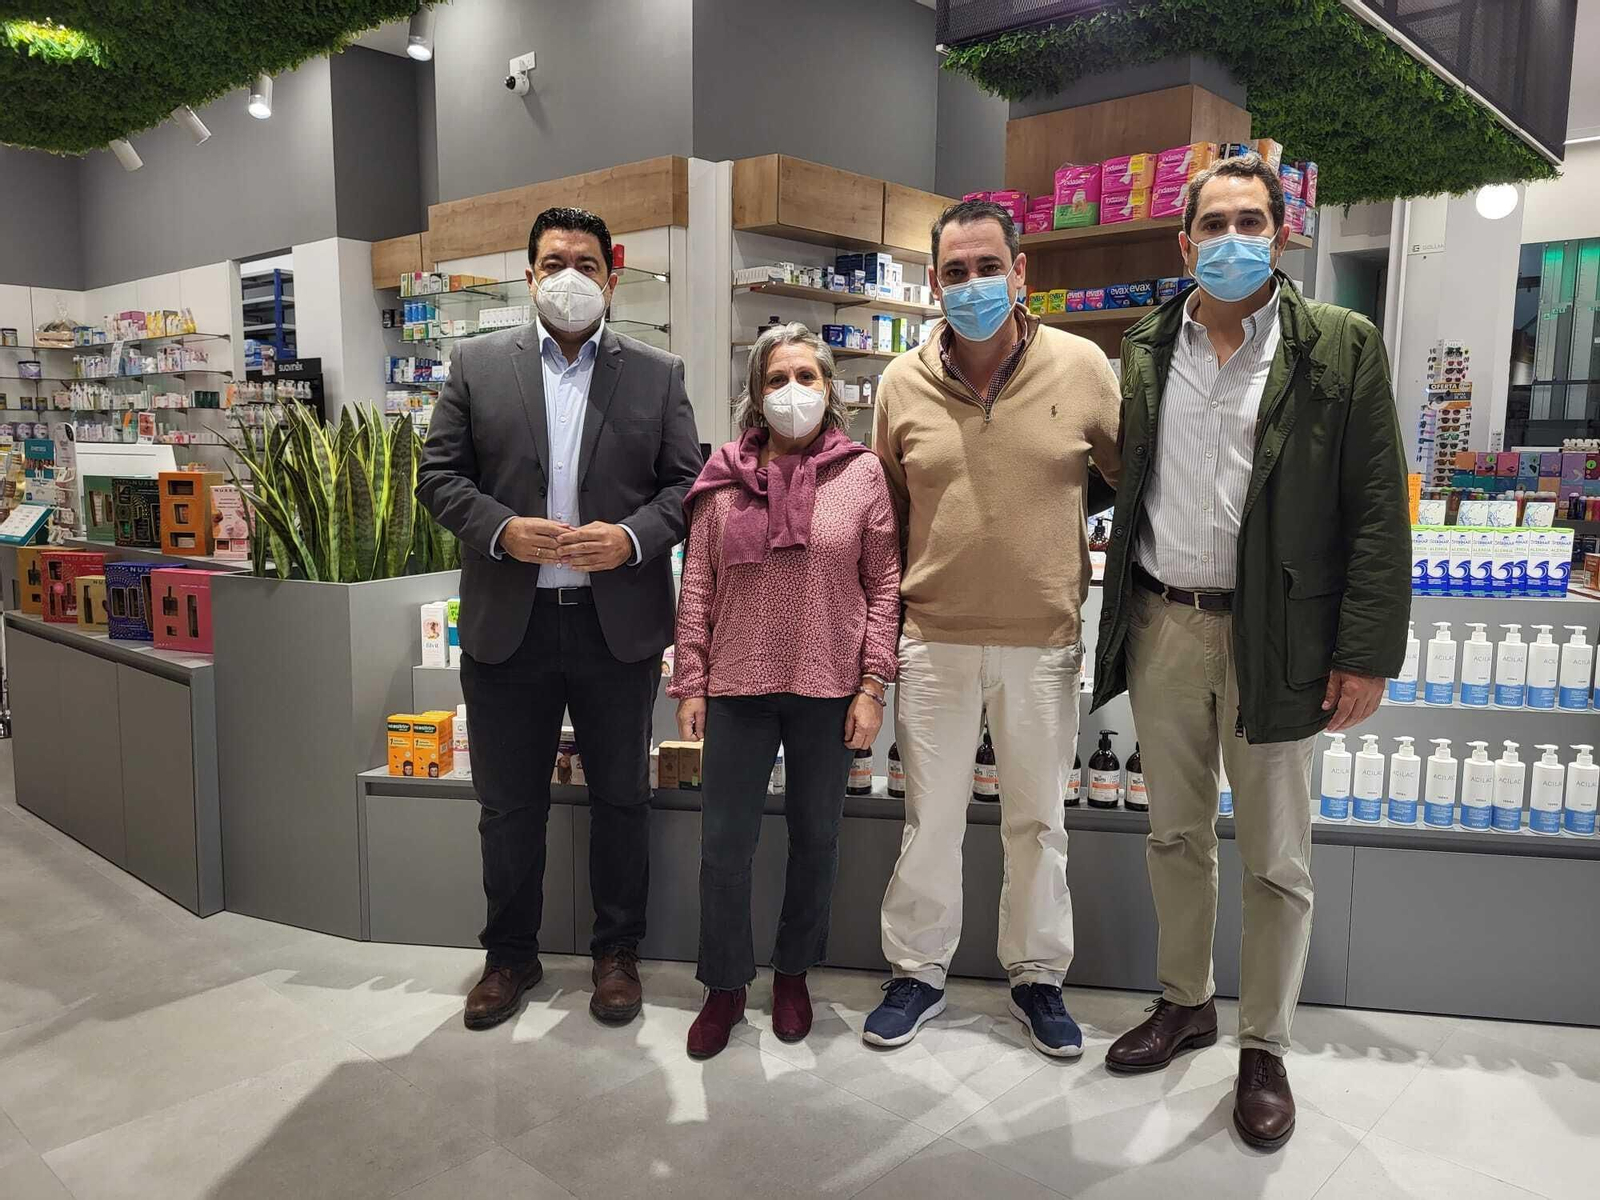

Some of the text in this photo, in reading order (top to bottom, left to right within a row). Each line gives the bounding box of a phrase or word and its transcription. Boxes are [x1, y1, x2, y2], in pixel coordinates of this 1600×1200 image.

[1110, 286, 1130, 295] evax
[1130, 282, 1150, 292] evax
[1086, 290, 1104, 298] evax
